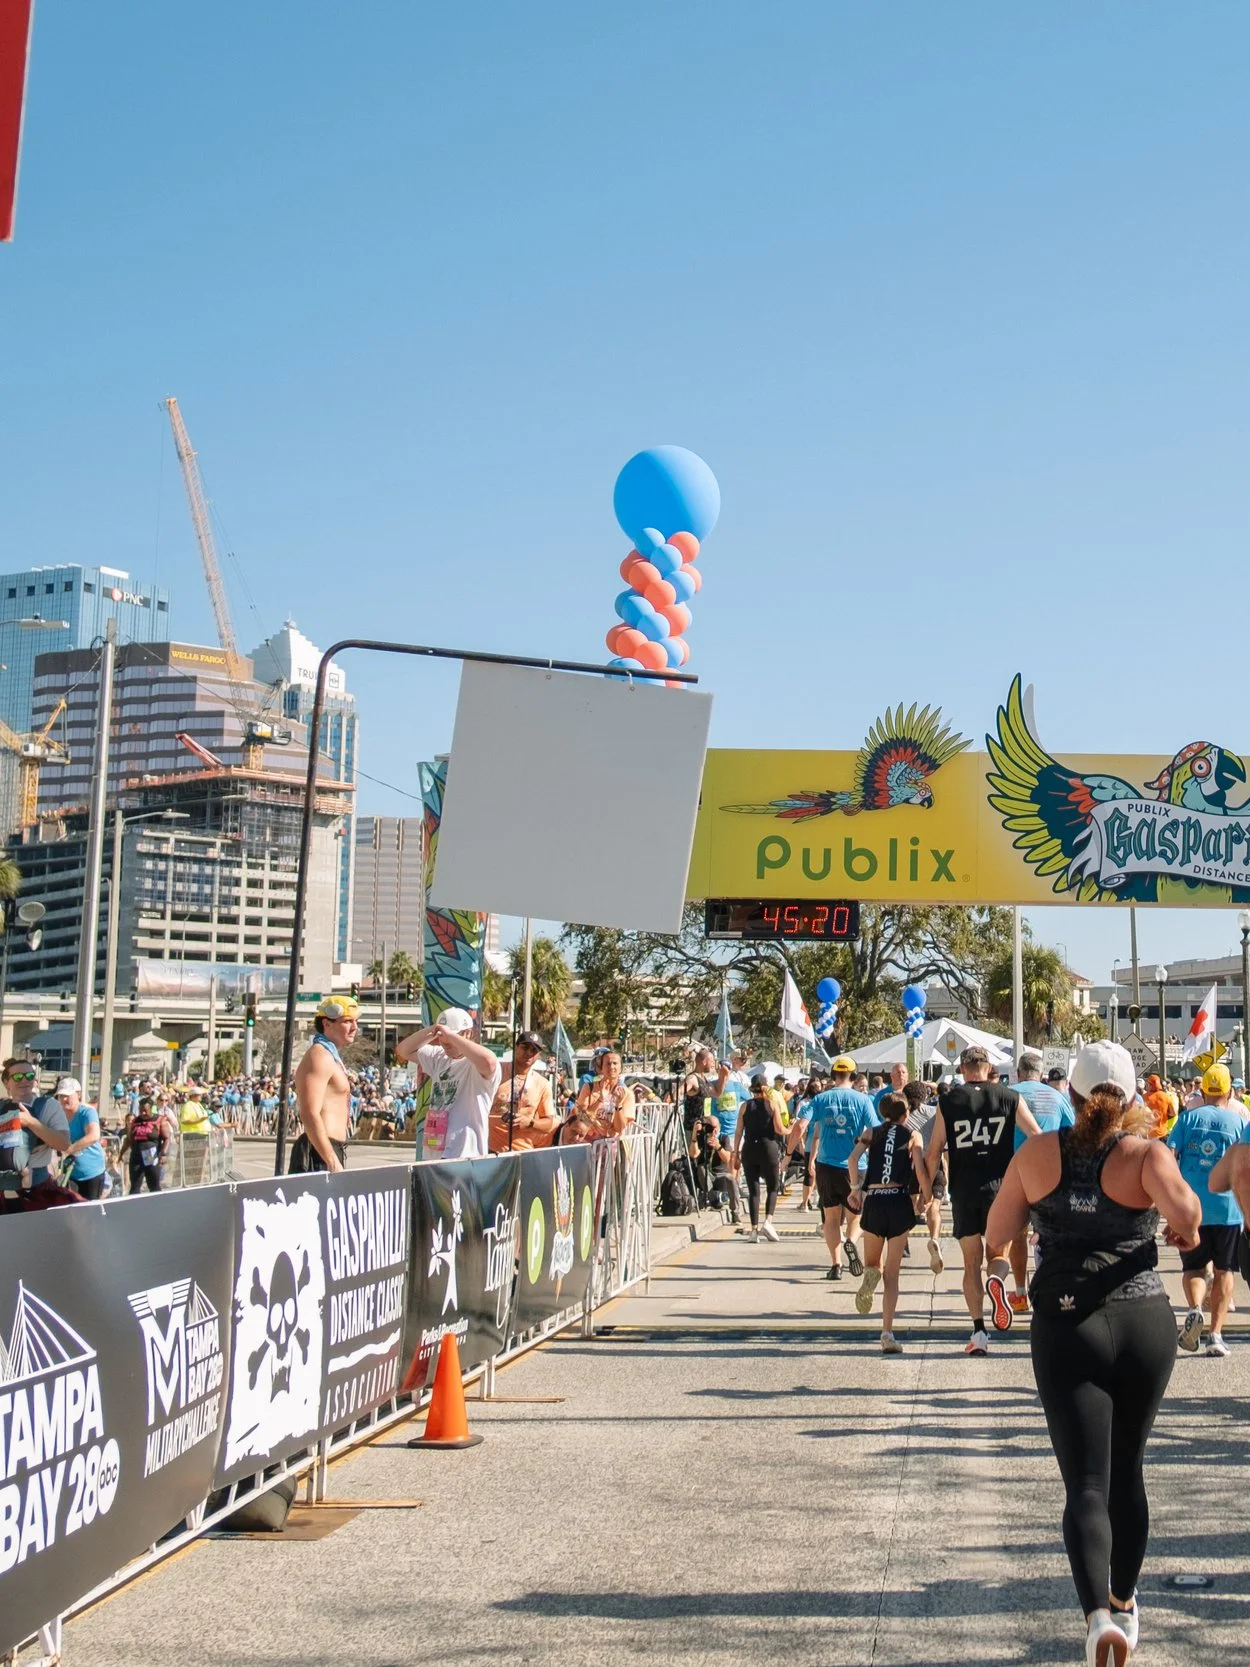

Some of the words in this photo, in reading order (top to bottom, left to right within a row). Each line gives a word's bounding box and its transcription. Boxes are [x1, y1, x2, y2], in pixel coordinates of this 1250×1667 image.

[123, 590, 144, 606] PNC
[171, 650, 199, 662] WELLS
[199, 653, 226, 665] FARGO
[297, 667, 319, 681] TRU
[1127, 803, 1171, 818] PUBLIX
[757, 835, 956, 882] Publix
[1193, 864, 1250, 882] DISTANCE
[884, 1124, 898, 1153] NIKE
[953, 1116, 1006, 1149] 247
[326, 1188, 407, 1282] GASPARILLA
[330, 1283, 376, 1346] DISTANCE
[376, 1273, 405, 1328] CLASSIC
[186, 1318, 220, 1370] TAMPA
[188, 1357, 210, 1404] BAY
[0, 1363, 104, 1482] TAMPA
[0, 1458, 67, 1574] BAY
[65, 1444, 101, 1536] 28
[99, 1460, 118, 1490] abc
